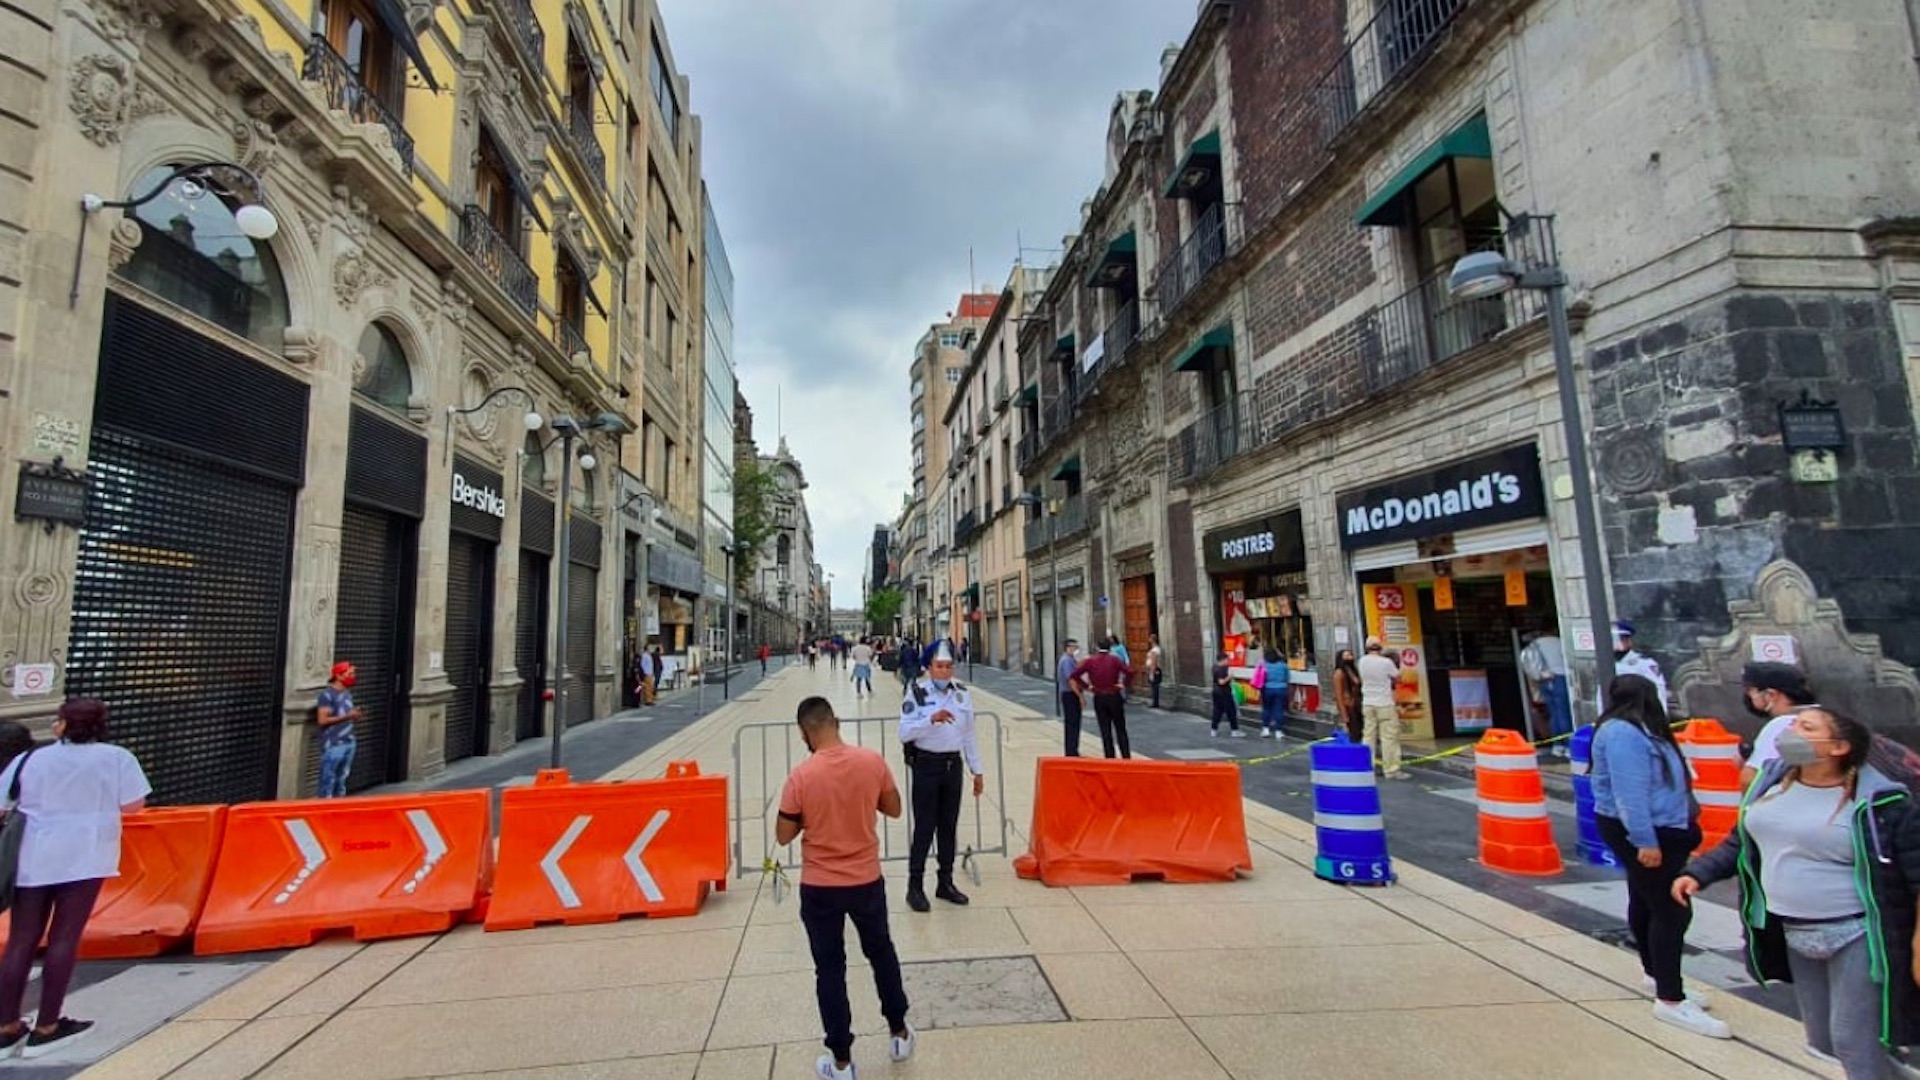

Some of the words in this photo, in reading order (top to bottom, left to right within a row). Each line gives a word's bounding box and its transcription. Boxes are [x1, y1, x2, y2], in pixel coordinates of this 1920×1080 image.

[452, 473, 506, 518] Bershka
[1347, 472, 1521, 535] McDonald's
[1222, 532, 1275, 559] POSTRES
[1340, 862, 1355, 877] G
[1371, 862, 1383, 878] S
